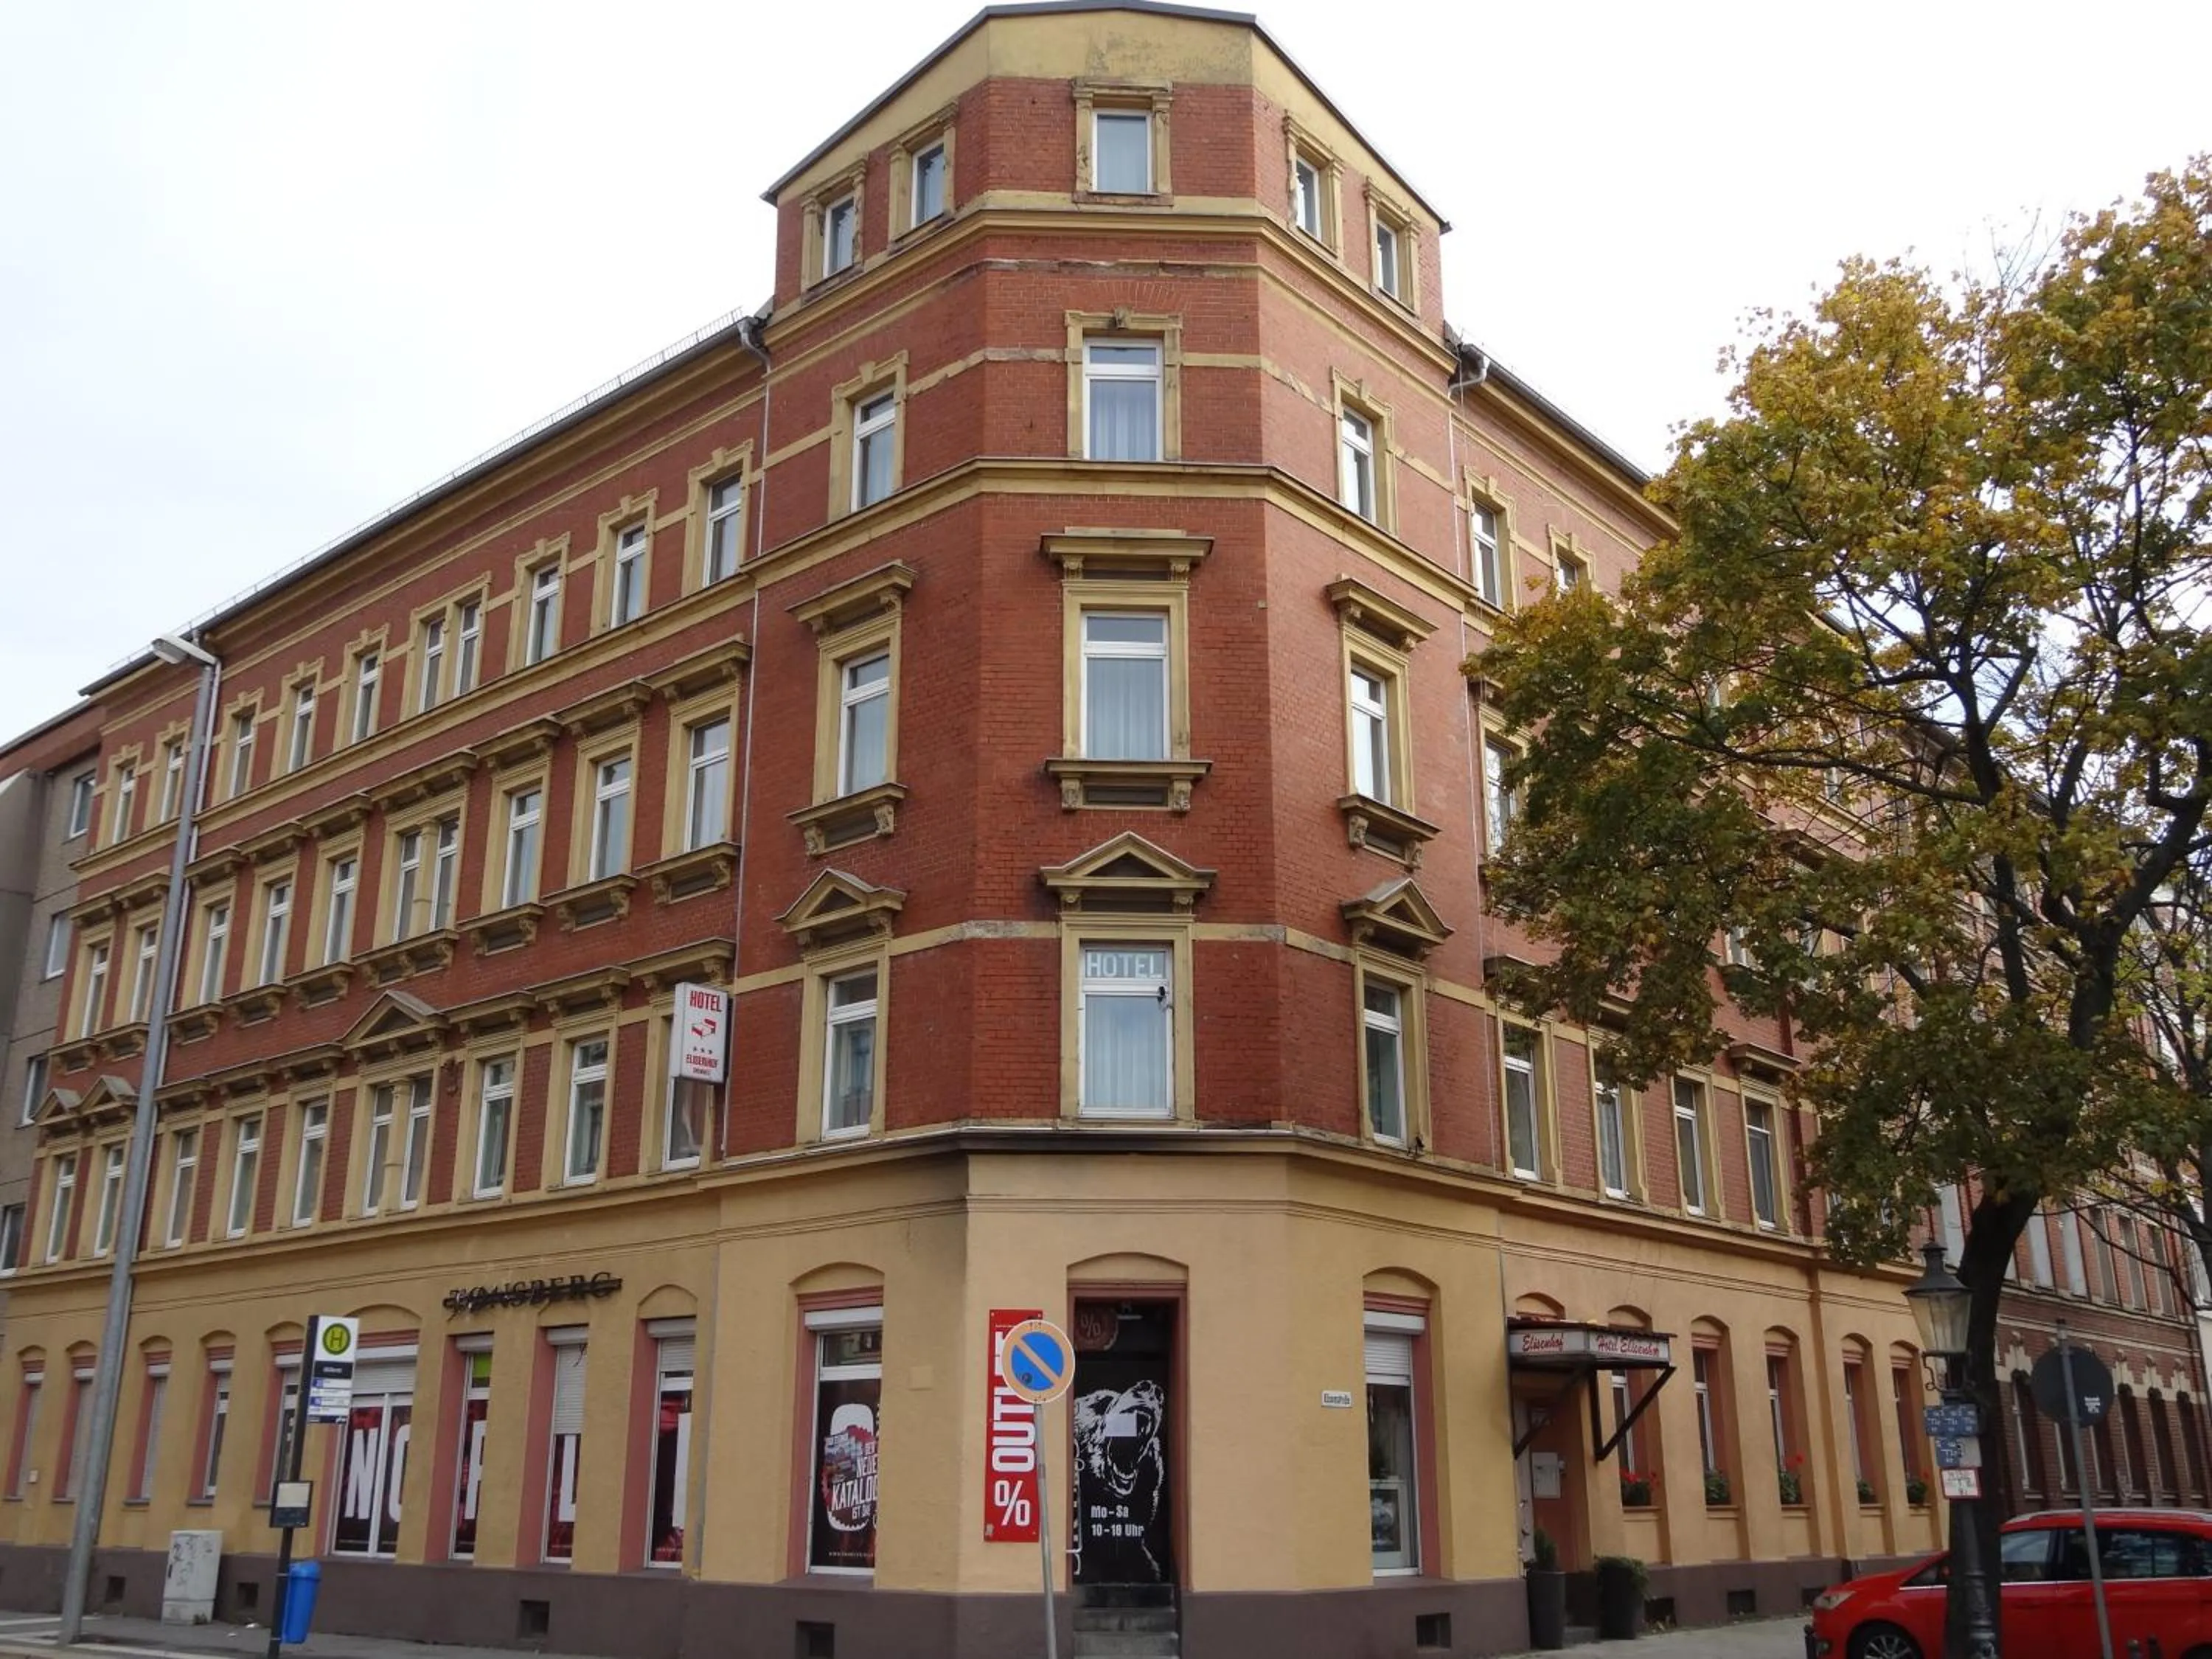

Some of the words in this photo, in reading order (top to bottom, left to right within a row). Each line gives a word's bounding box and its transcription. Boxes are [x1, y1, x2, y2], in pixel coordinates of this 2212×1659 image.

[1086, 951, 1164, 978] HOTEL
[689, 990, 722, 1012] HOTEL
[992, 1332, 1035, 1472] OUT
[994, 1479, 1031, 1526] %
[1124, 1523, 1145, 1537] Uhr
